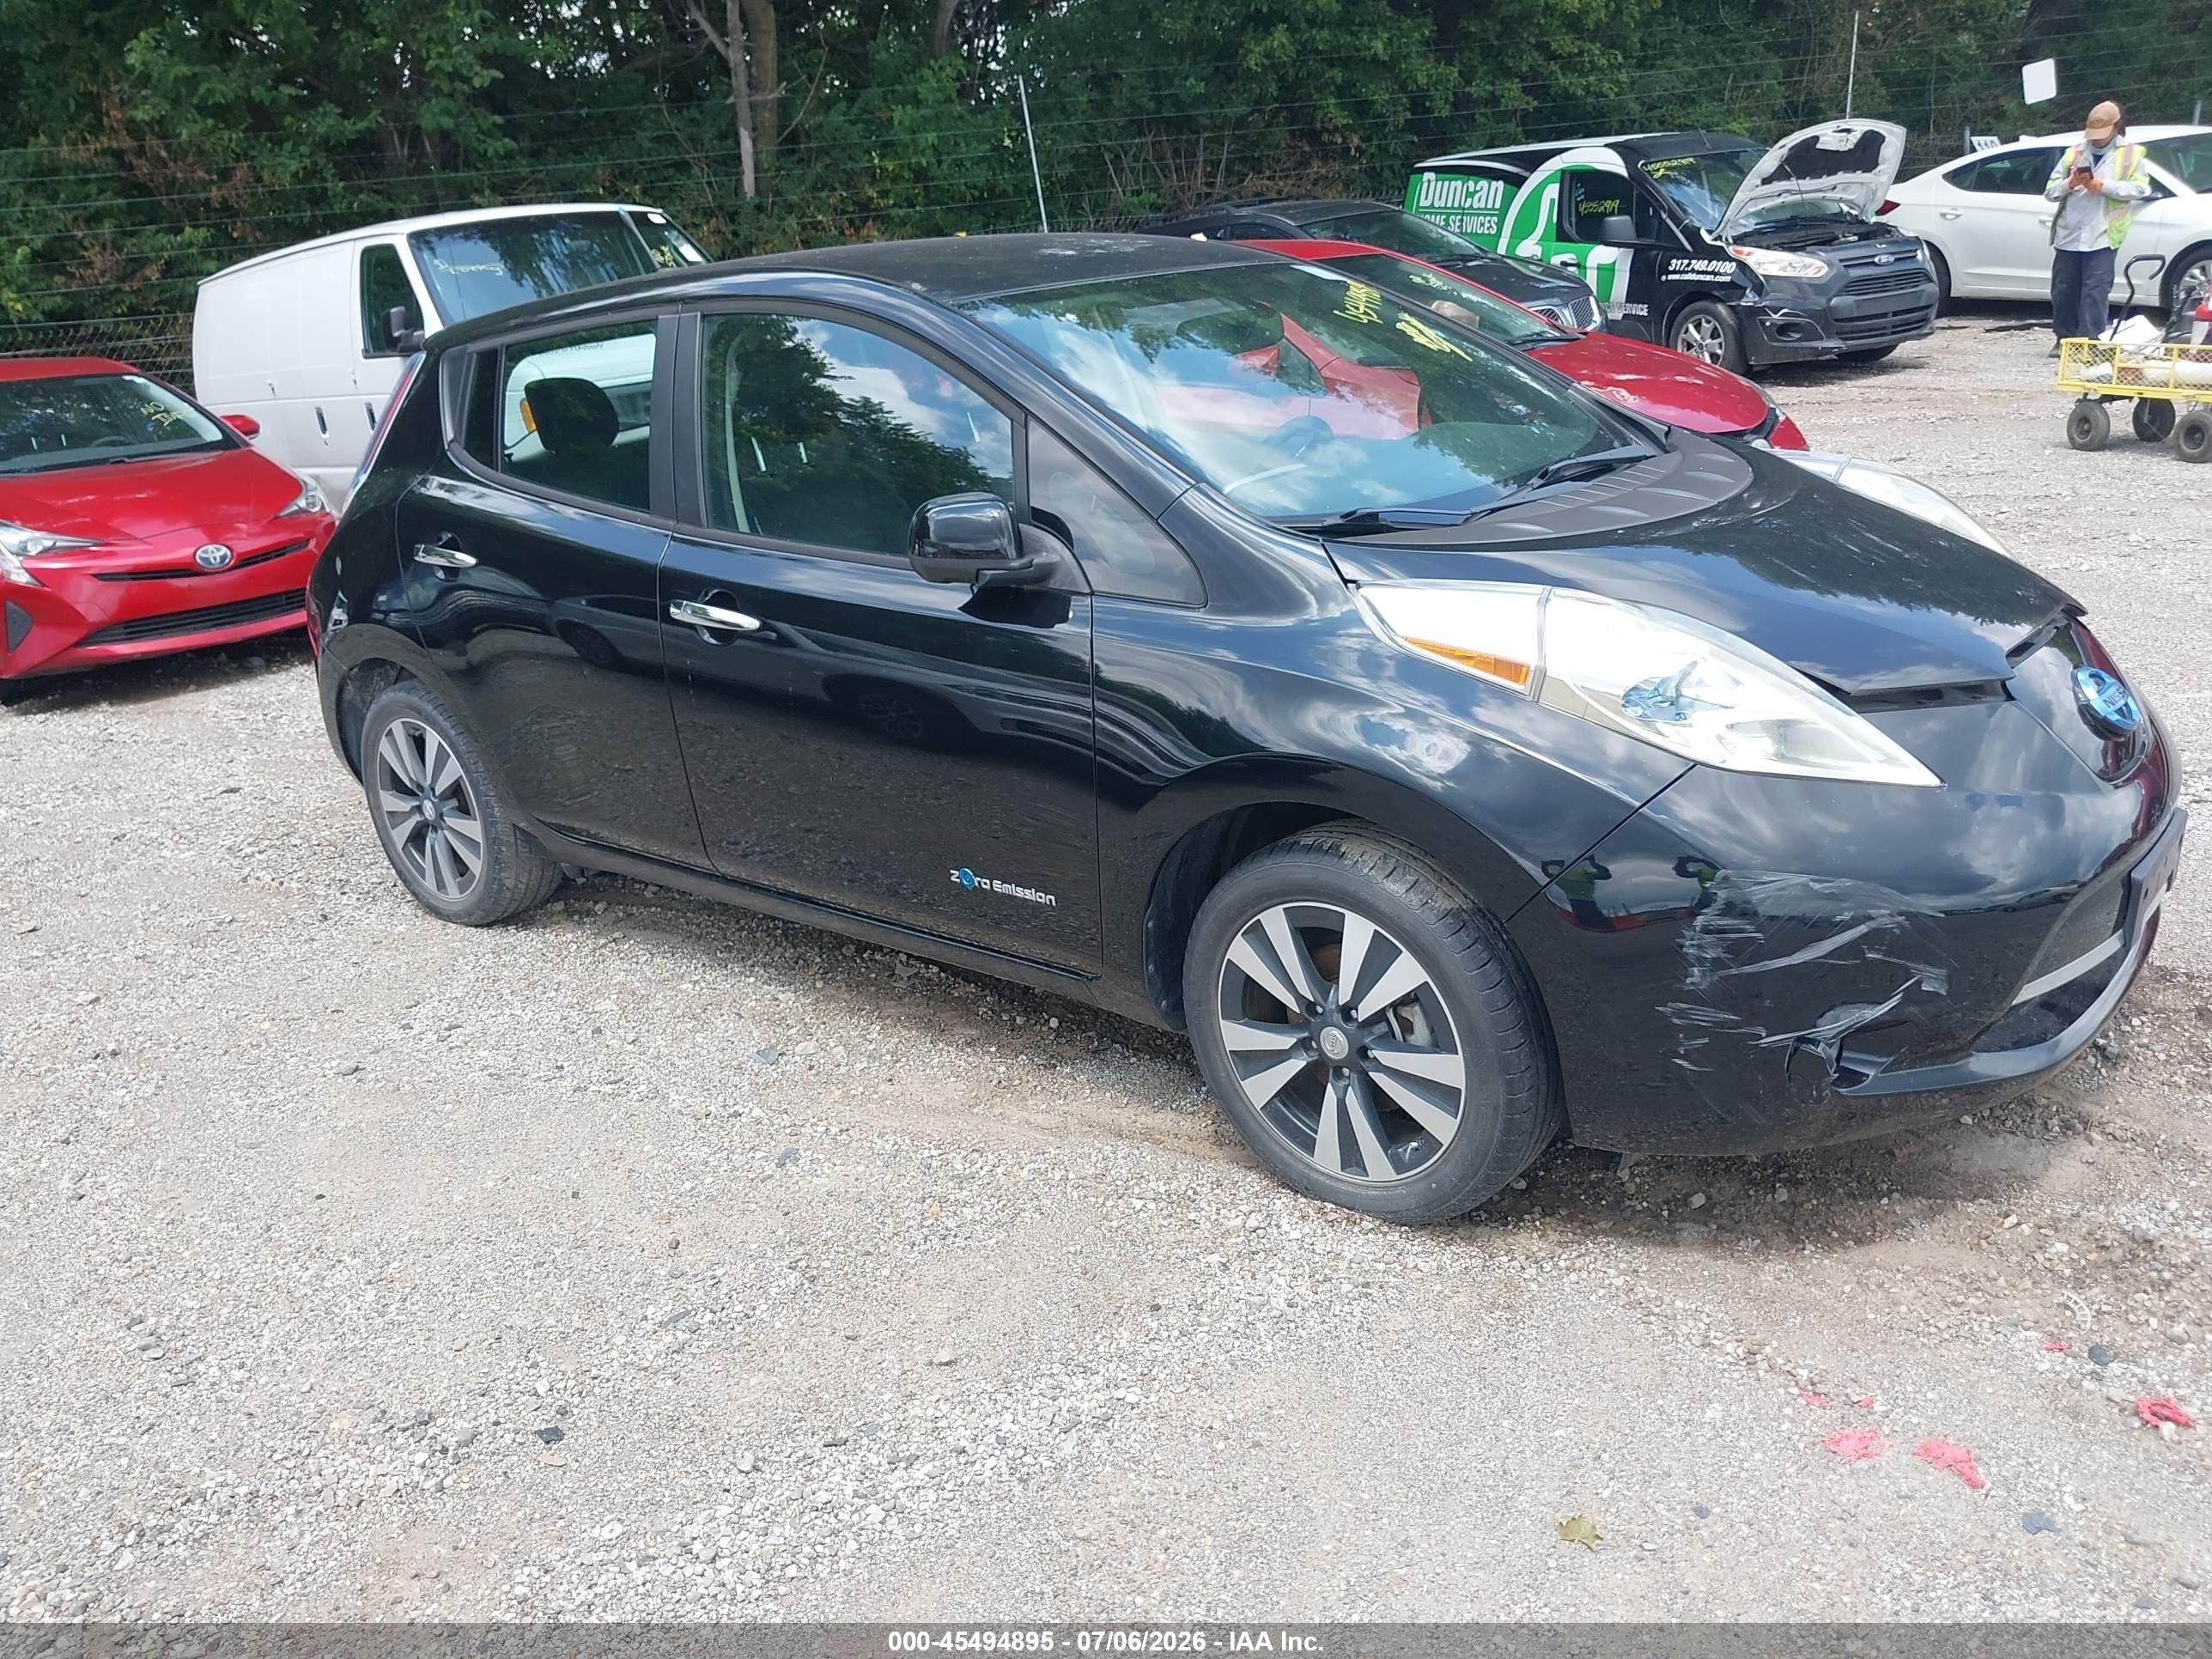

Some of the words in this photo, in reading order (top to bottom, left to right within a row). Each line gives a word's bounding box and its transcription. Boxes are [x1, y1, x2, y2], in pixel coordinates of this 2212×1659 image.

[1419, 171, 1504, 209] Duncan
[1448, 215, 1498, 234] SERVICES
[1668, 258, 1737, 274] 317.749.0100
[992, 879, 1057, 907] Emission
